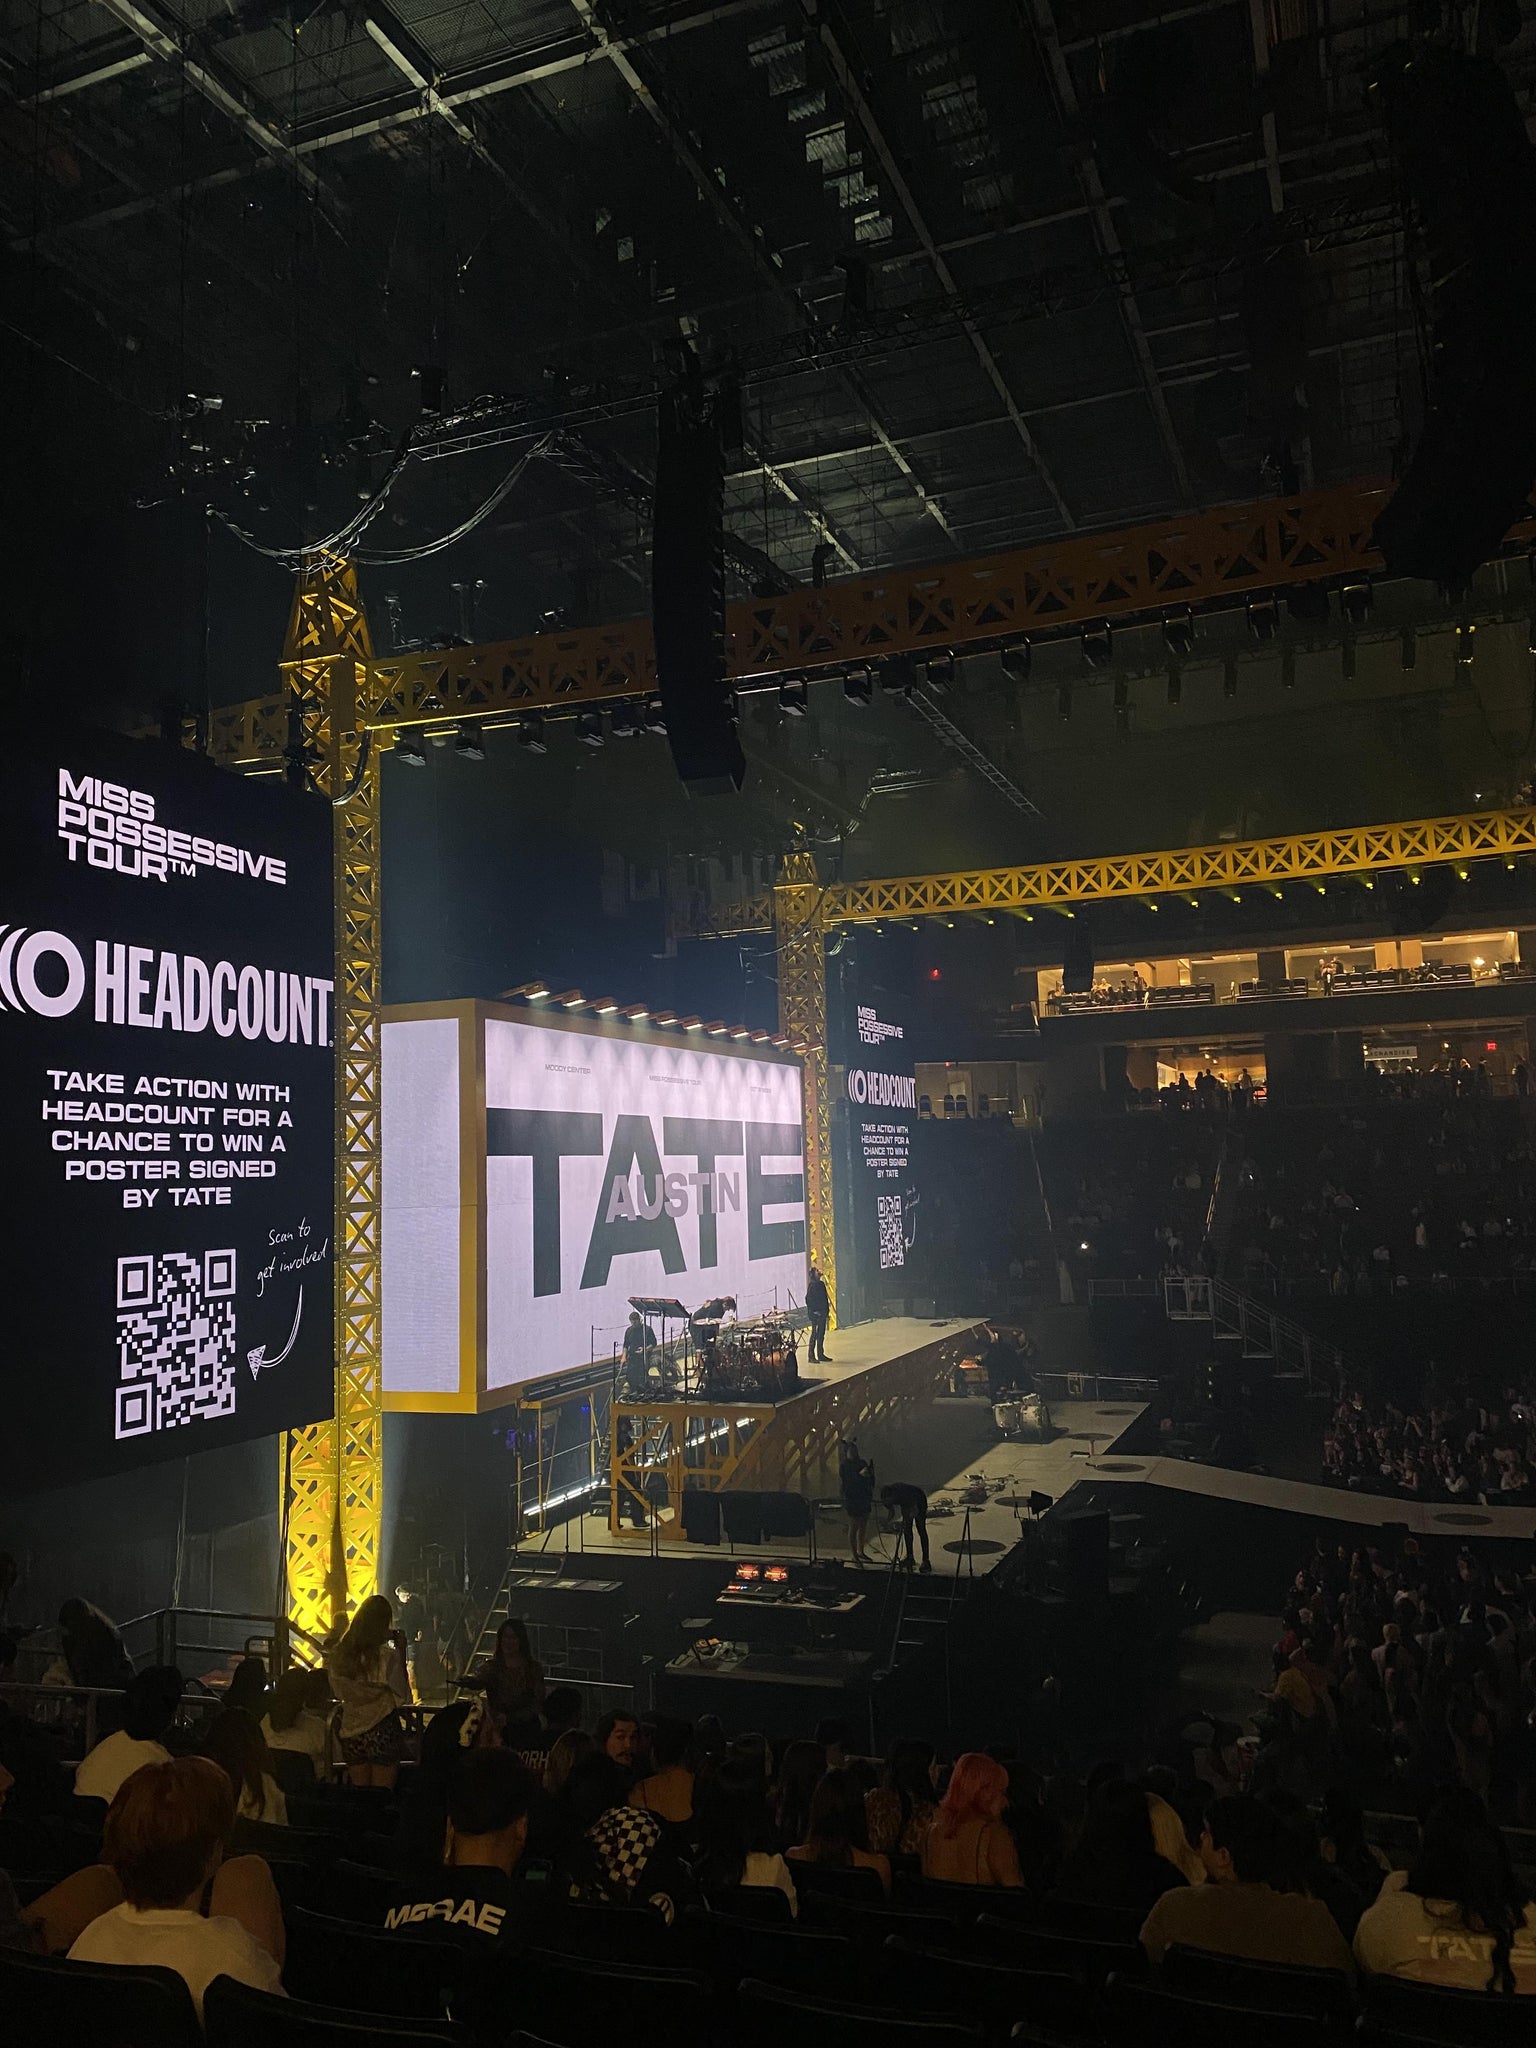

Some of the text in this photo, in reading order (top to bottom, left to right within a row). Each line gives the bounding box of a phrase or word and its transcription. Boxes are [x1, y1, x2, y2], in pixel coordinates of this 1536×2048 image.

[59, 768, 155, 822] MISS
[58, 798, 287, 885] POSSESSIVE
[857, 1005, 876, 1021] MISS
[858, 1017, 904, 1039] POSSESSIVE
[545, 1063, 591, 1075] MOODY CENTER
[46, 1069, 290, 1103] TAKE ACTION WITH
[866, 1071, 917, 1109] HEADCOUNT
[42, 1099, 293, 1128] HEADCOUNT FOR A
[861, 1123, 909, 1134] TAKE ACTION WITH
[51, 1130, 287, 1152] CHANCE TO WIN A
[861, 1135, 910, 1145] HEADCOUNT FOR A
[863, 1146, 909, 1156] CHANCE TO WIN A
[65, 1160, 276, 1181] POSTER SIGNED
[866, 1158, 908, 1167] POSTER SIGNED
[877, 1169, 899, 1178] BY TATE
[123, 1186, 232, 1209] BY TATE
[487, 1107, 806, 1298] TATE
[605, 1172, 741, 1224] AUSTIN
[268, 1216, 311, 1246] Scan to
[256, 1237, 329, 1298] get involved
